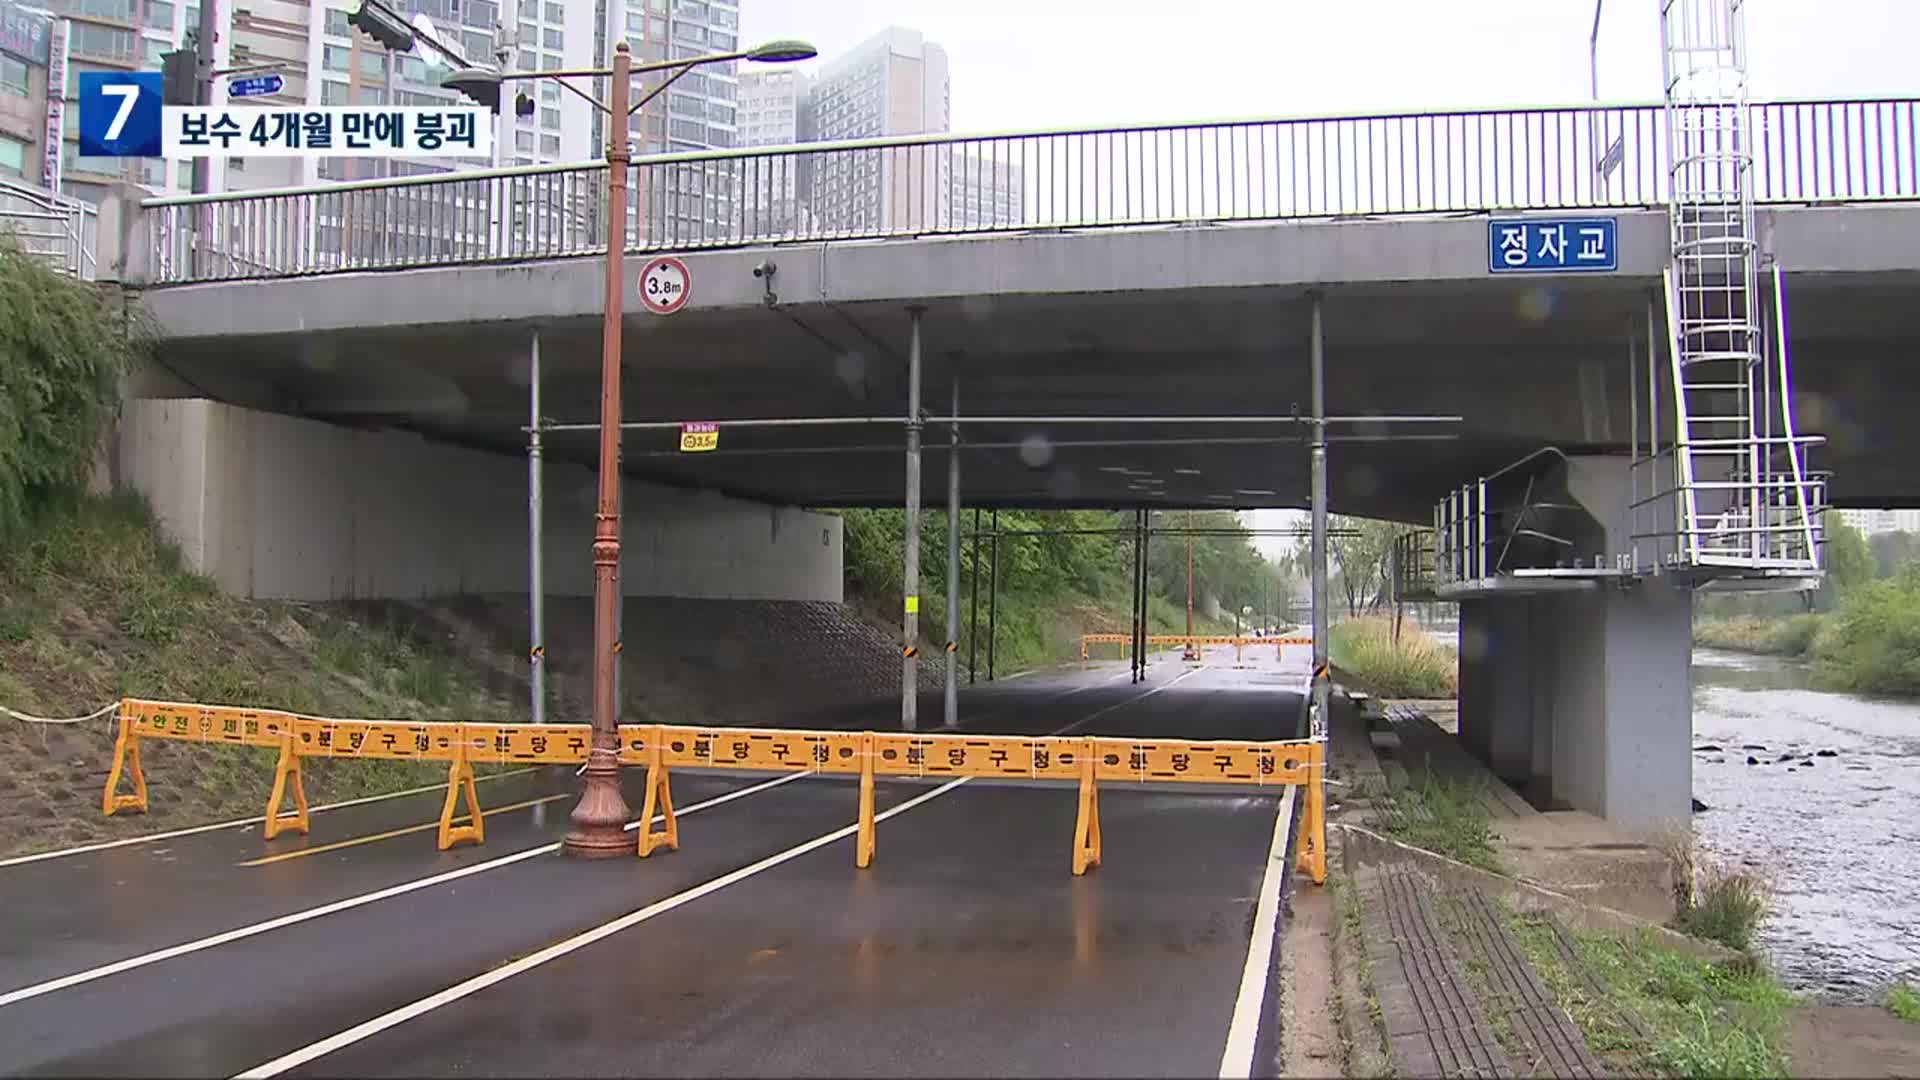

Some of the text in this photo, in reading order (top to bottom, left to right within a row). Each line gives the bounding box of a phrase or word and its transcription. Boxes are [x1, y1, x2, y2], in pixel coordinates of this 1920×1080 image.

[1500, 224, 1606, 265] 정자교
[648, 277, 681, 294] 3.8m
[693, 740, 830, 763] 분당구청
[907, 747, 1050, 769] 분당구청
[1129, 752, 1275, 775] 분당구청
